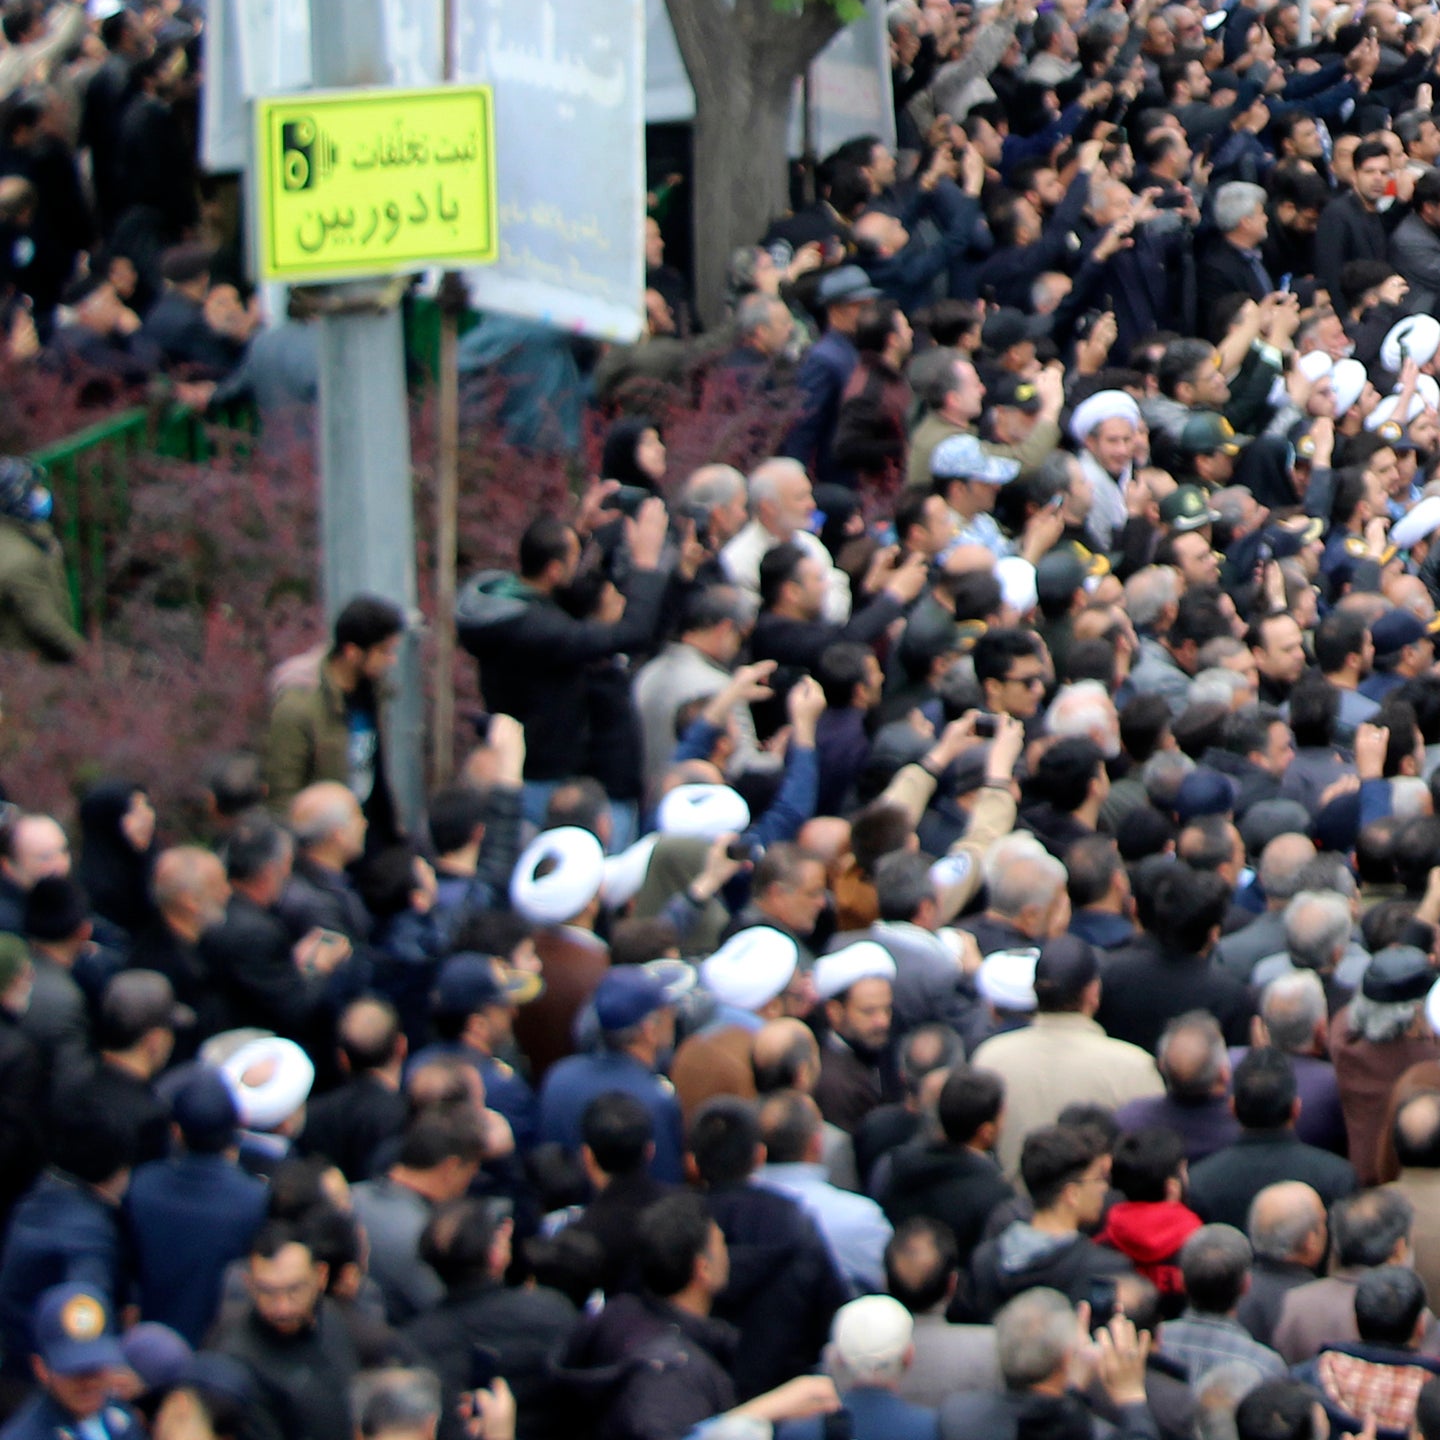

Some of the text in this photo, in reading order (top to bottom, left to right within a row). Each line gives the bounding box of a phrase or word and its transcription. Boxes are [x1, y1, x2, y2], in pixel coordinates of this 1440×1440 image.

[434, 127, 478, 172] ثبت
[297, 190, 429, 253] دوربین
[436, 182, 459, 236] با
